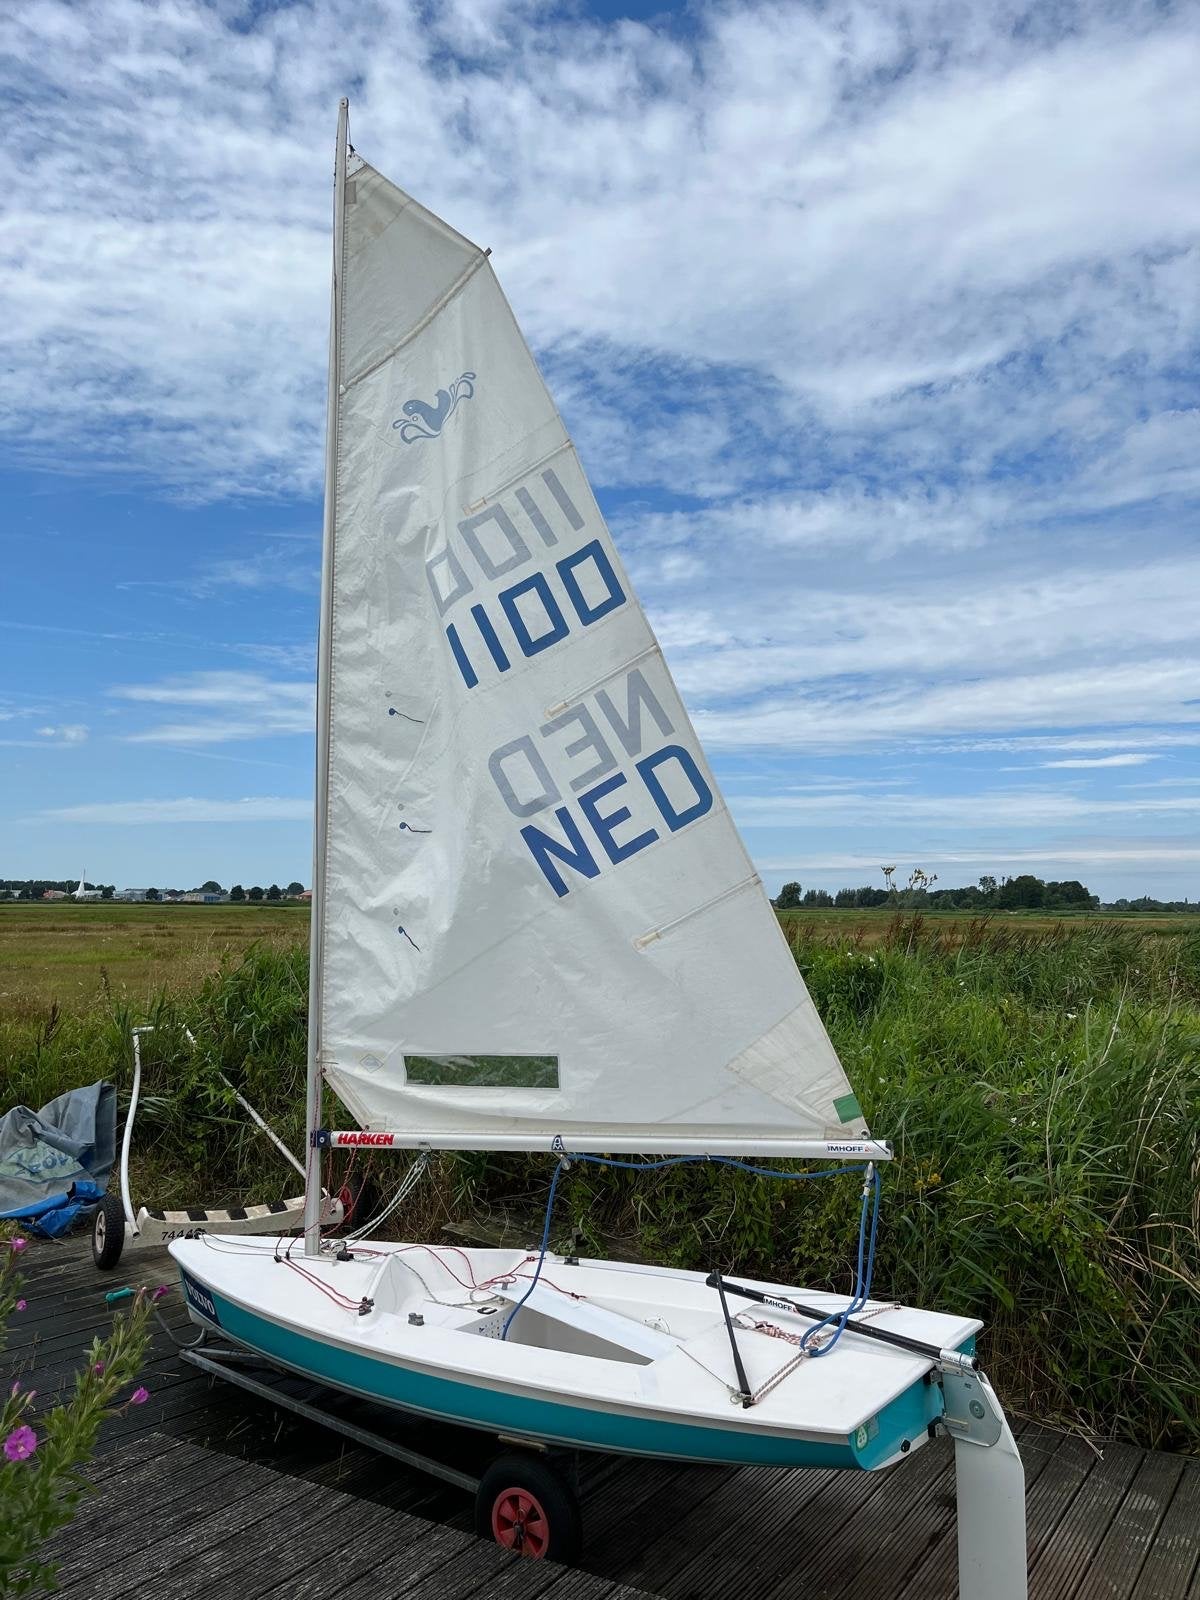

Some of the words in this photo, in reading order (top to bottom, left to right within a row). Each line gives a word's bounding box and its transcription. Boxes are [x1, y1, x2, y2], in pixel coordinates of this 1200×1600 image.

[445, 538, 627, 689] 1100
[519, 744, 714, 898] NED
[337, 1133, 395, 1146] HARKEN
[826, 1145, 863, 1153] IMHOFF
